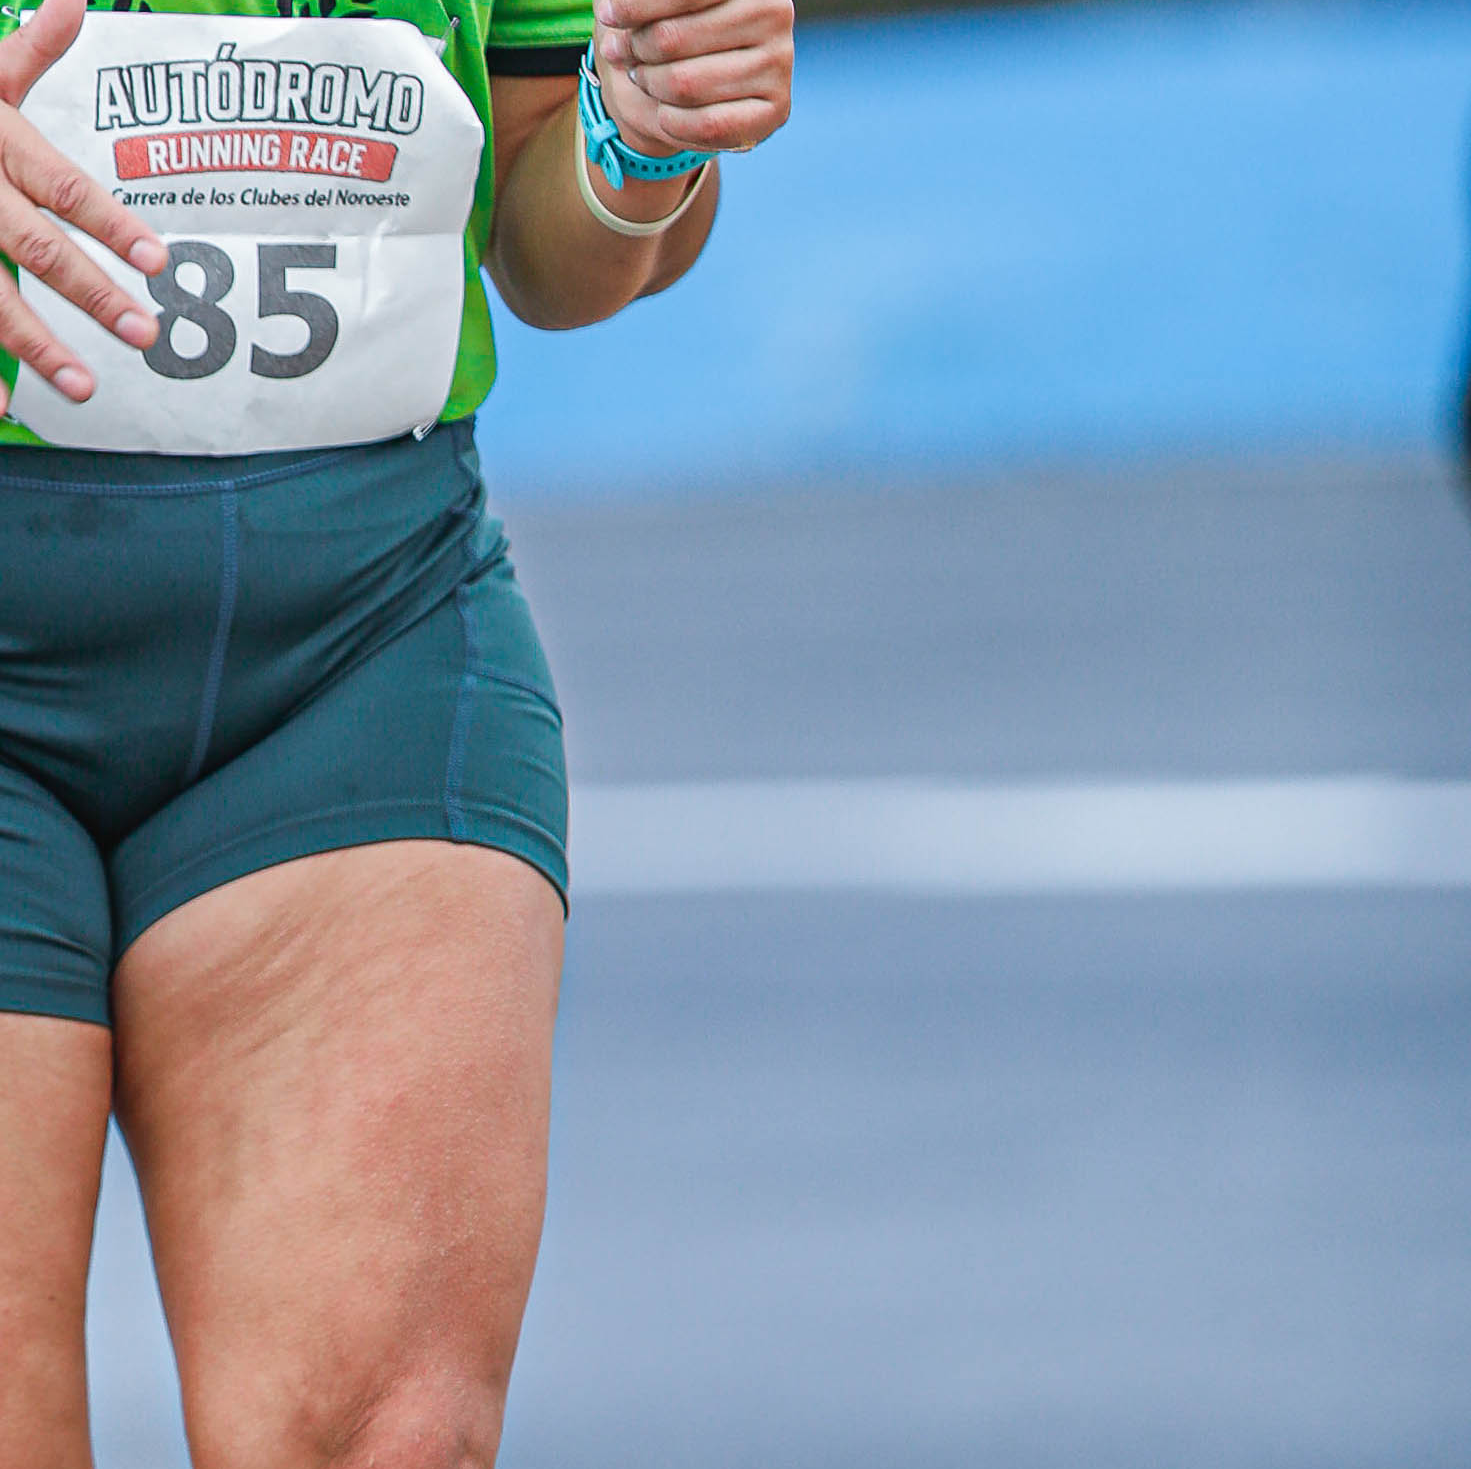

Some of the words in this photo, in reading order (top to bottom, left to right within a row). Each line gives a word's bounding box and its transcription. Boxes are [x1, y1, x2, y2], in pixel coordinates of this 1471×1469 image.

[95, 43, 424, 134] AUTÓDROMO
[147, 135, 281, 176] RUNNING
[288, 135, 368, 177] RACE
[181, 187, 205, 205] de
[210, 187, 235, 205] los
[240, 187, 300, 205] Clubes
[304, 188, 332, 206] del
[336, 189, 410, 206] Noroeste
[140, 240, 339, 380] 85
